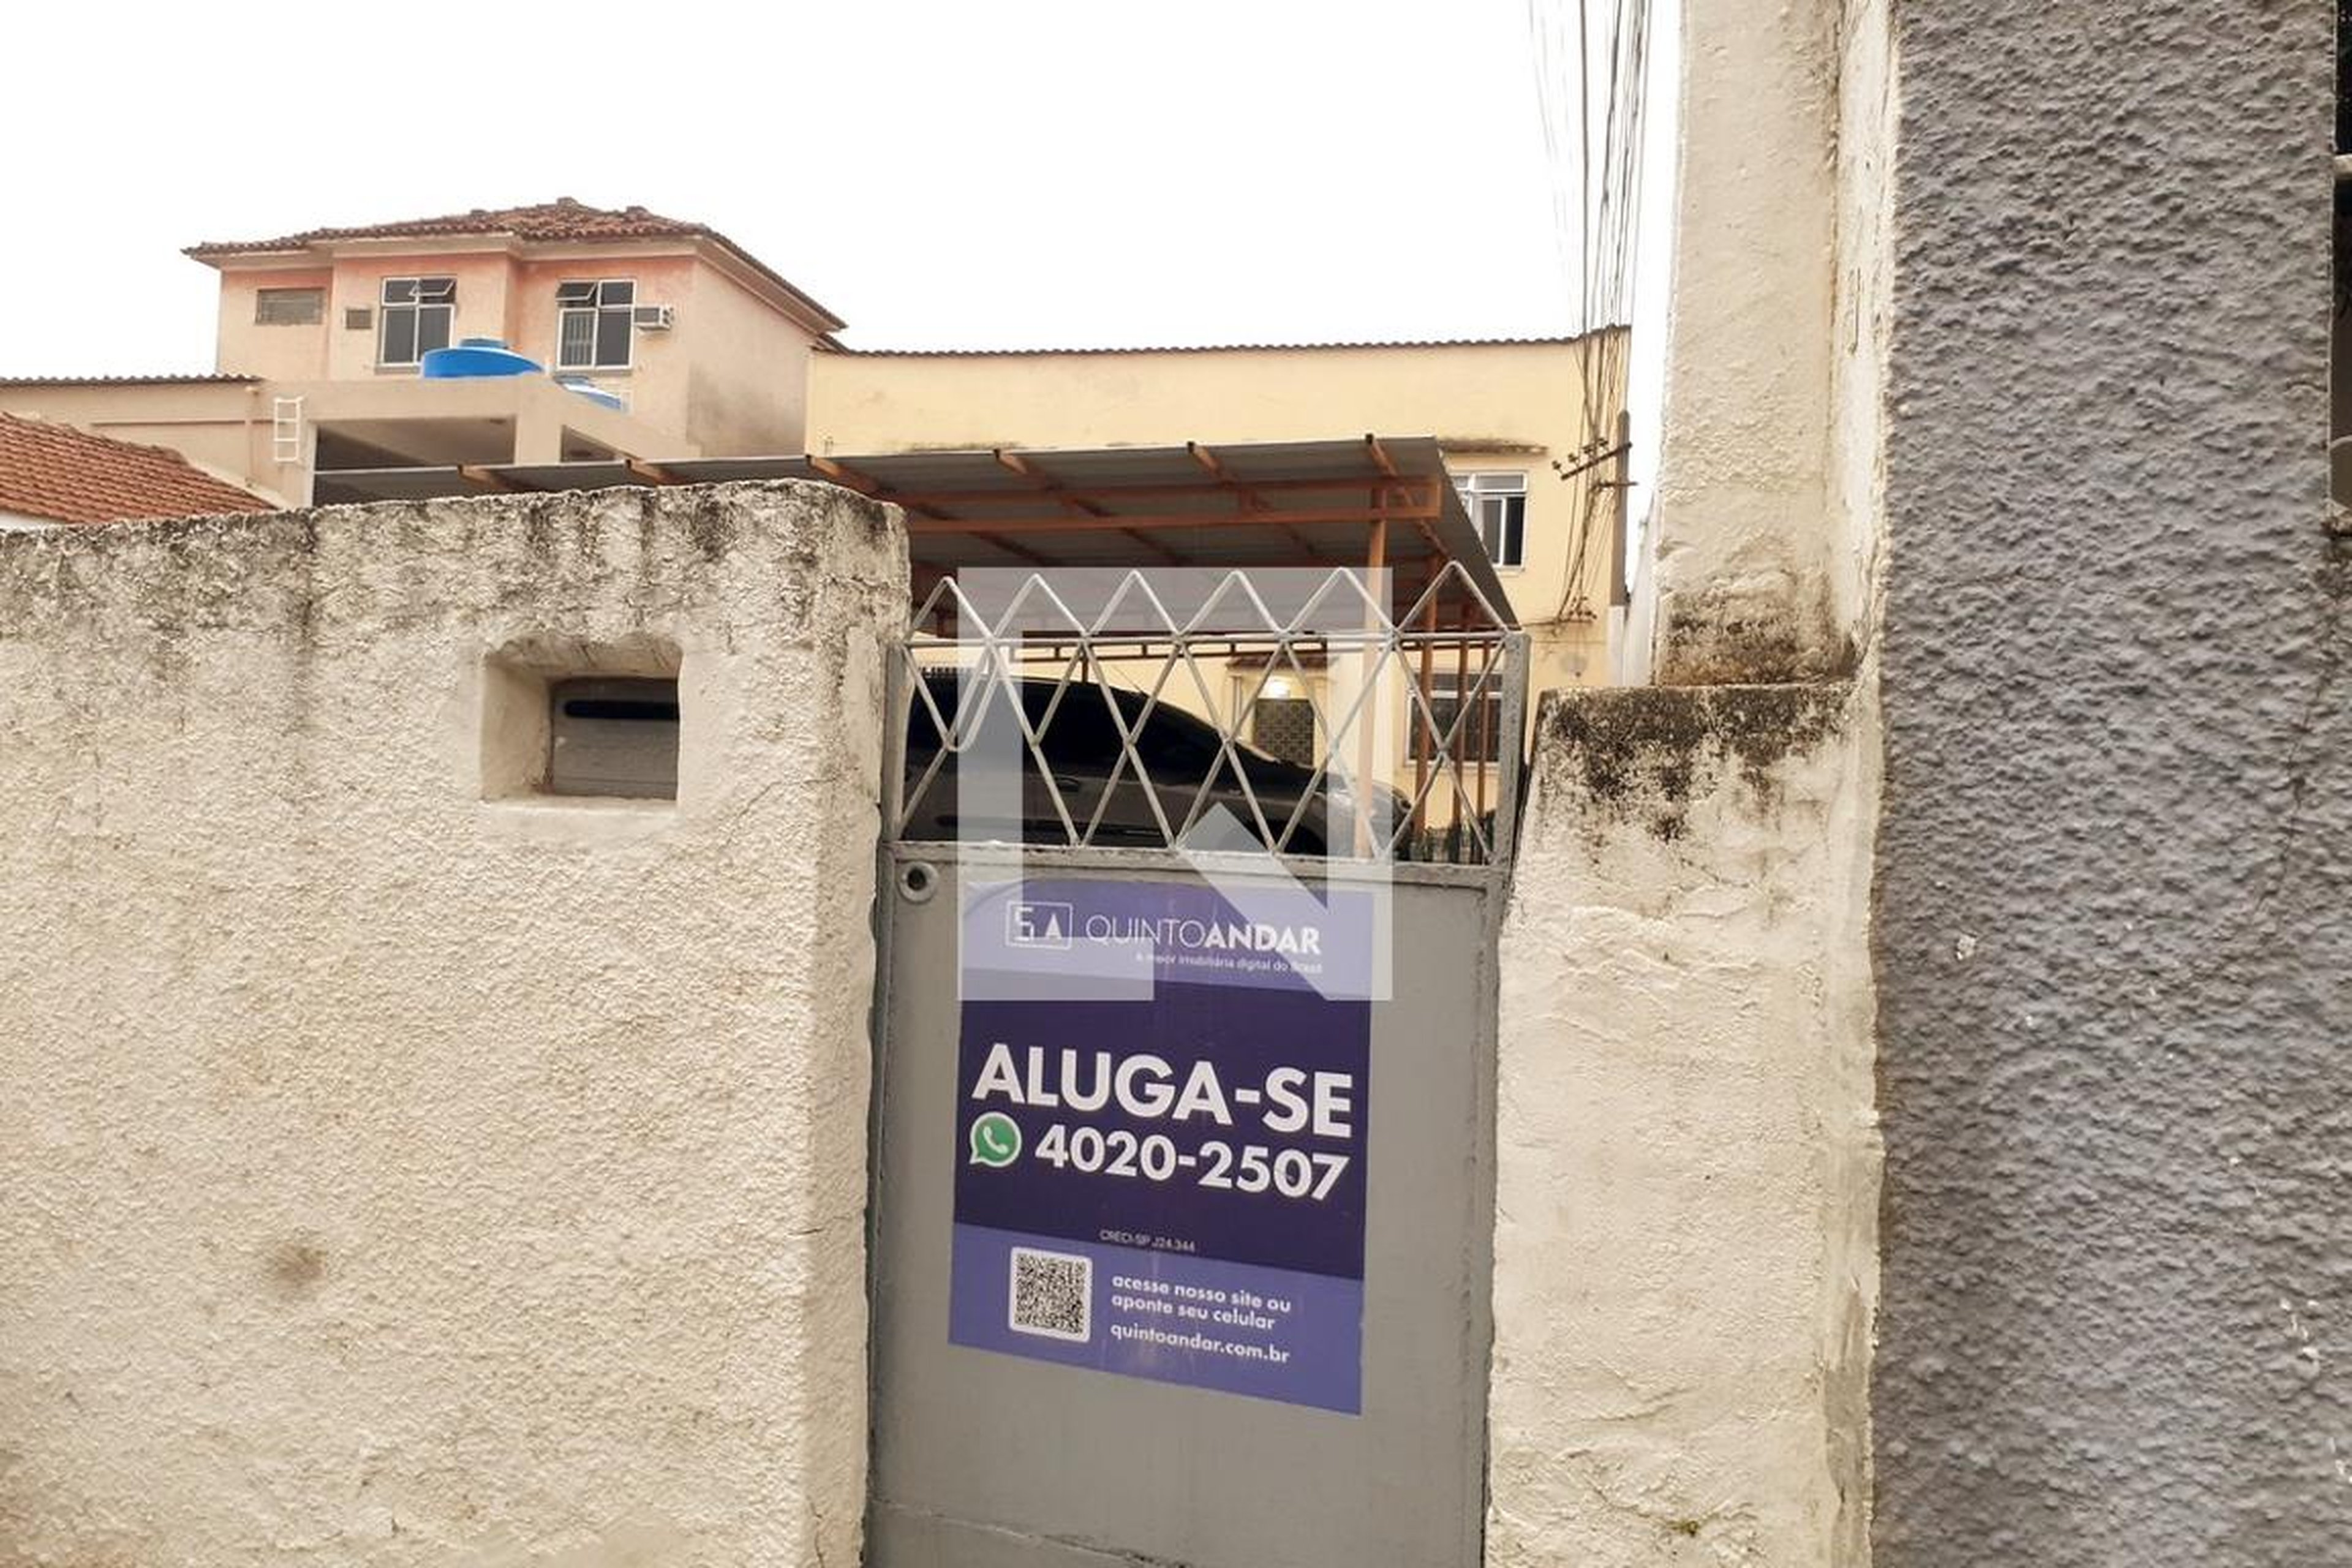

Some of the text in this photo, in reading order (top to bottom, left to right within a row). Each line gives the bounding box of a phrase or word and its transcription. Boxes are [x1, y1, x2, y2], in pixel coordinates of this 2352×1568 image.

[1085, 914, 1322, 955] QUINTOANDAR
[972, 1043, 1353, 1138] ALUGA-SE
[1035, 1124, 1349, 1200] 4020-2507
[1111, 1295, 1276, 1330] aponte seu celular
[1112, 1276, 1291, 1313] acesse nosso site ou
[1110, 1322, 1290, 1363] quintoandar.com.br
